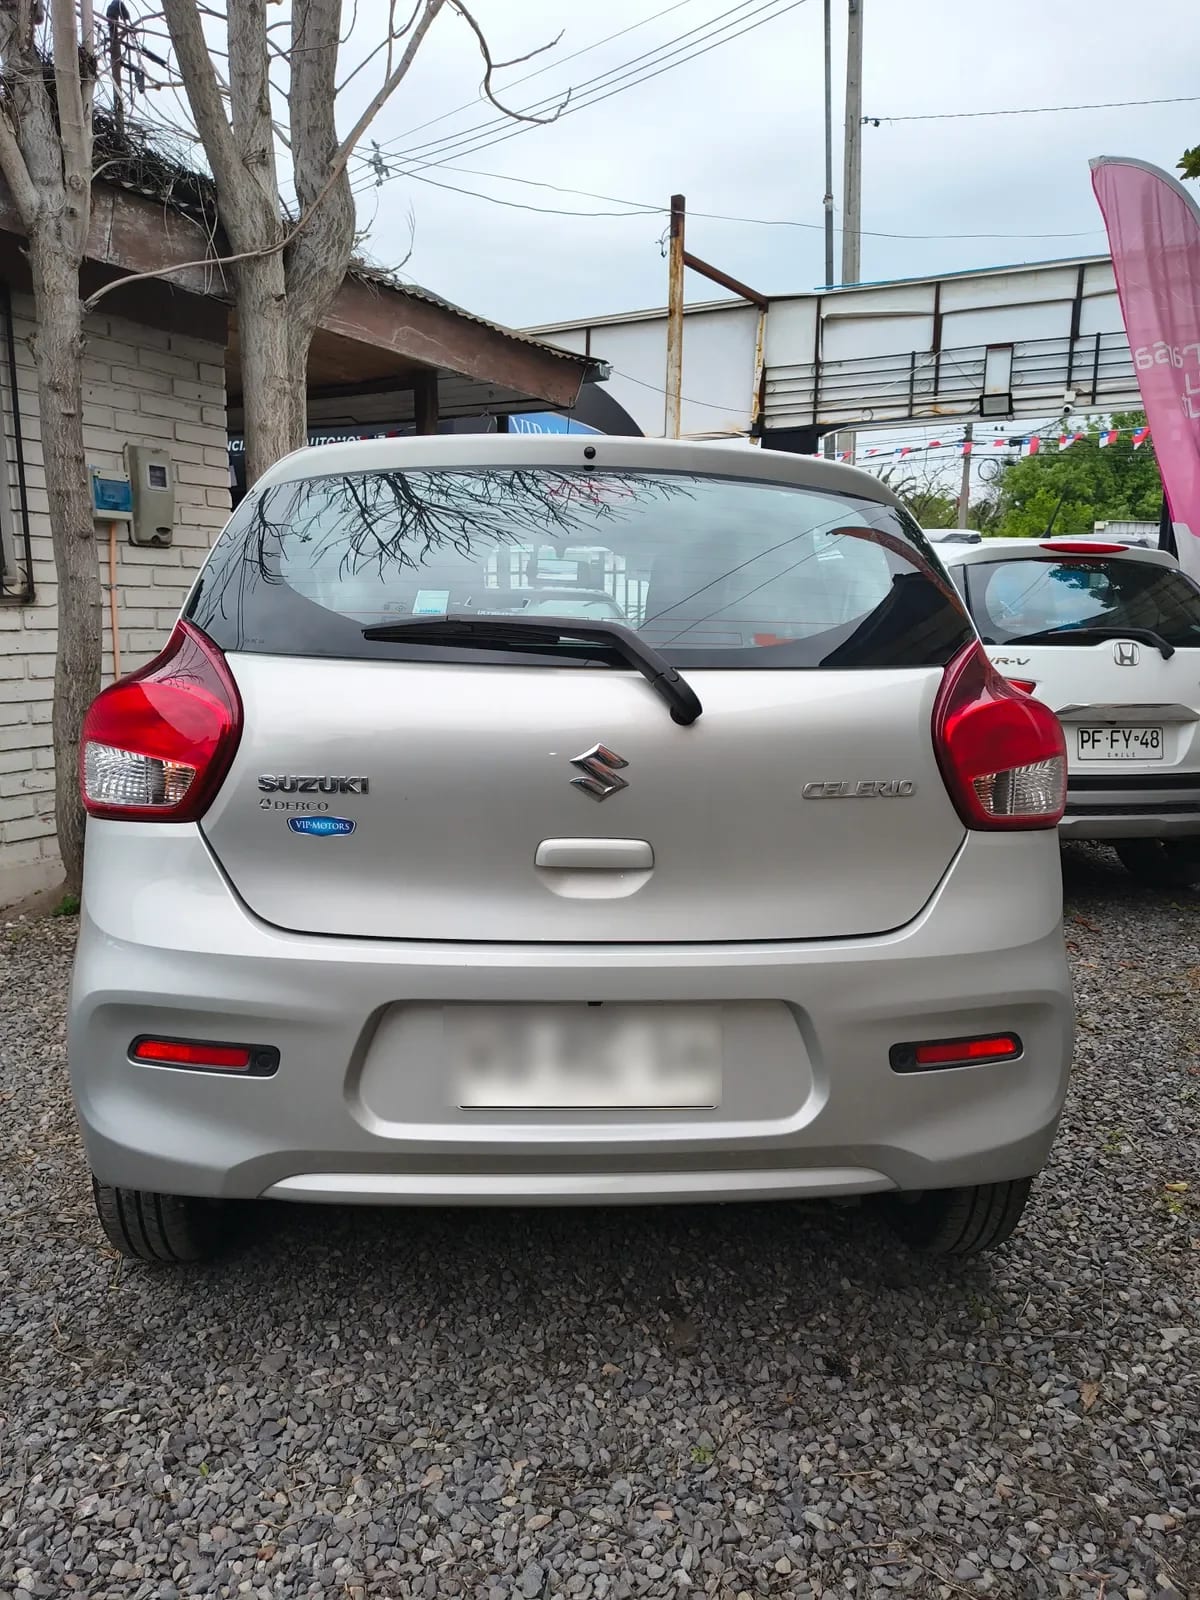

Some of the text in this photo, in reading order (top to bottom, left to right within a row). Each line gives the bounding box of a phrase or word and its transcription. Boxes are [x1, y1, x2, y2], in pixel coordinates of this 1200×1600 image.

[258, 774, 369, 794] SUZUKI
[802, 780, 916, 800] CELERIO
[274, 801, 329, 812] DERCO
